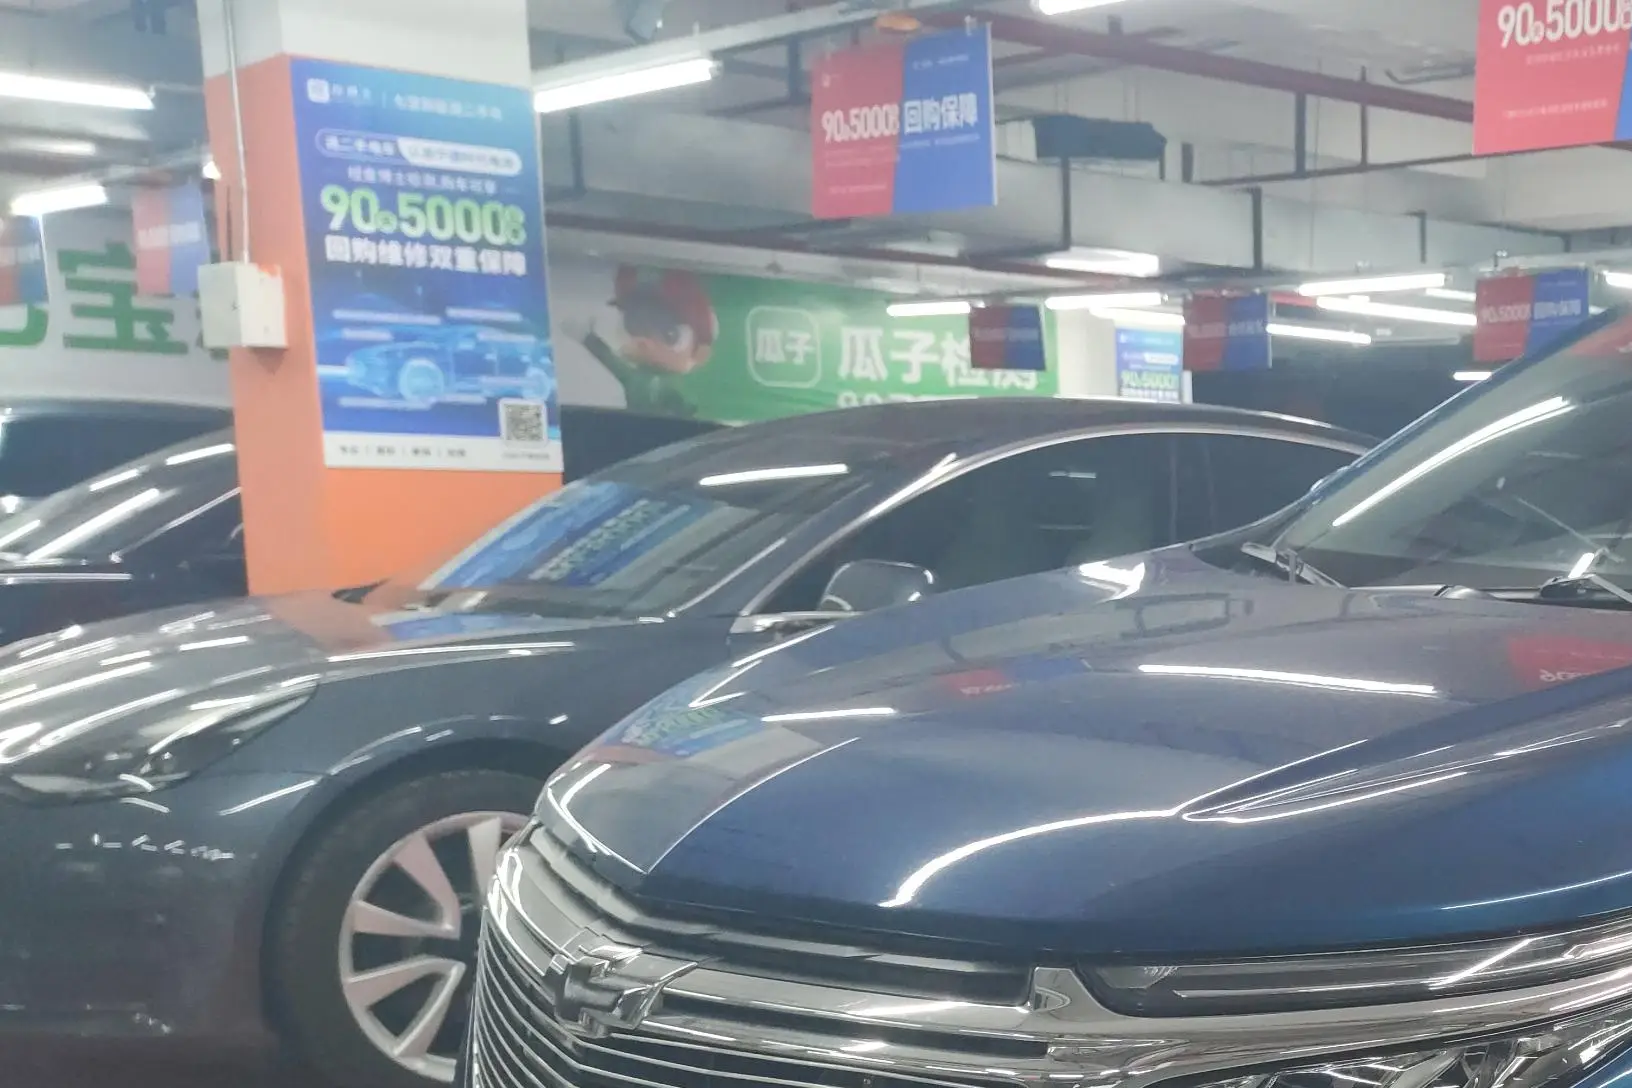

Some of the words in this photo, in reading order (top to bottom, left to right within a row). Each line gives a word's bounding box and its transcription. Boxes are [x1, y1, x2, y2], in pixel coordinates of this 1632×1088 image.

[821, 103, 900, 144] 905000
[904, 92, 978, 136] 回购保障
[755, 329, 816, 365] 瓜子
[838, 325, 1040, 391] 瓜子检
